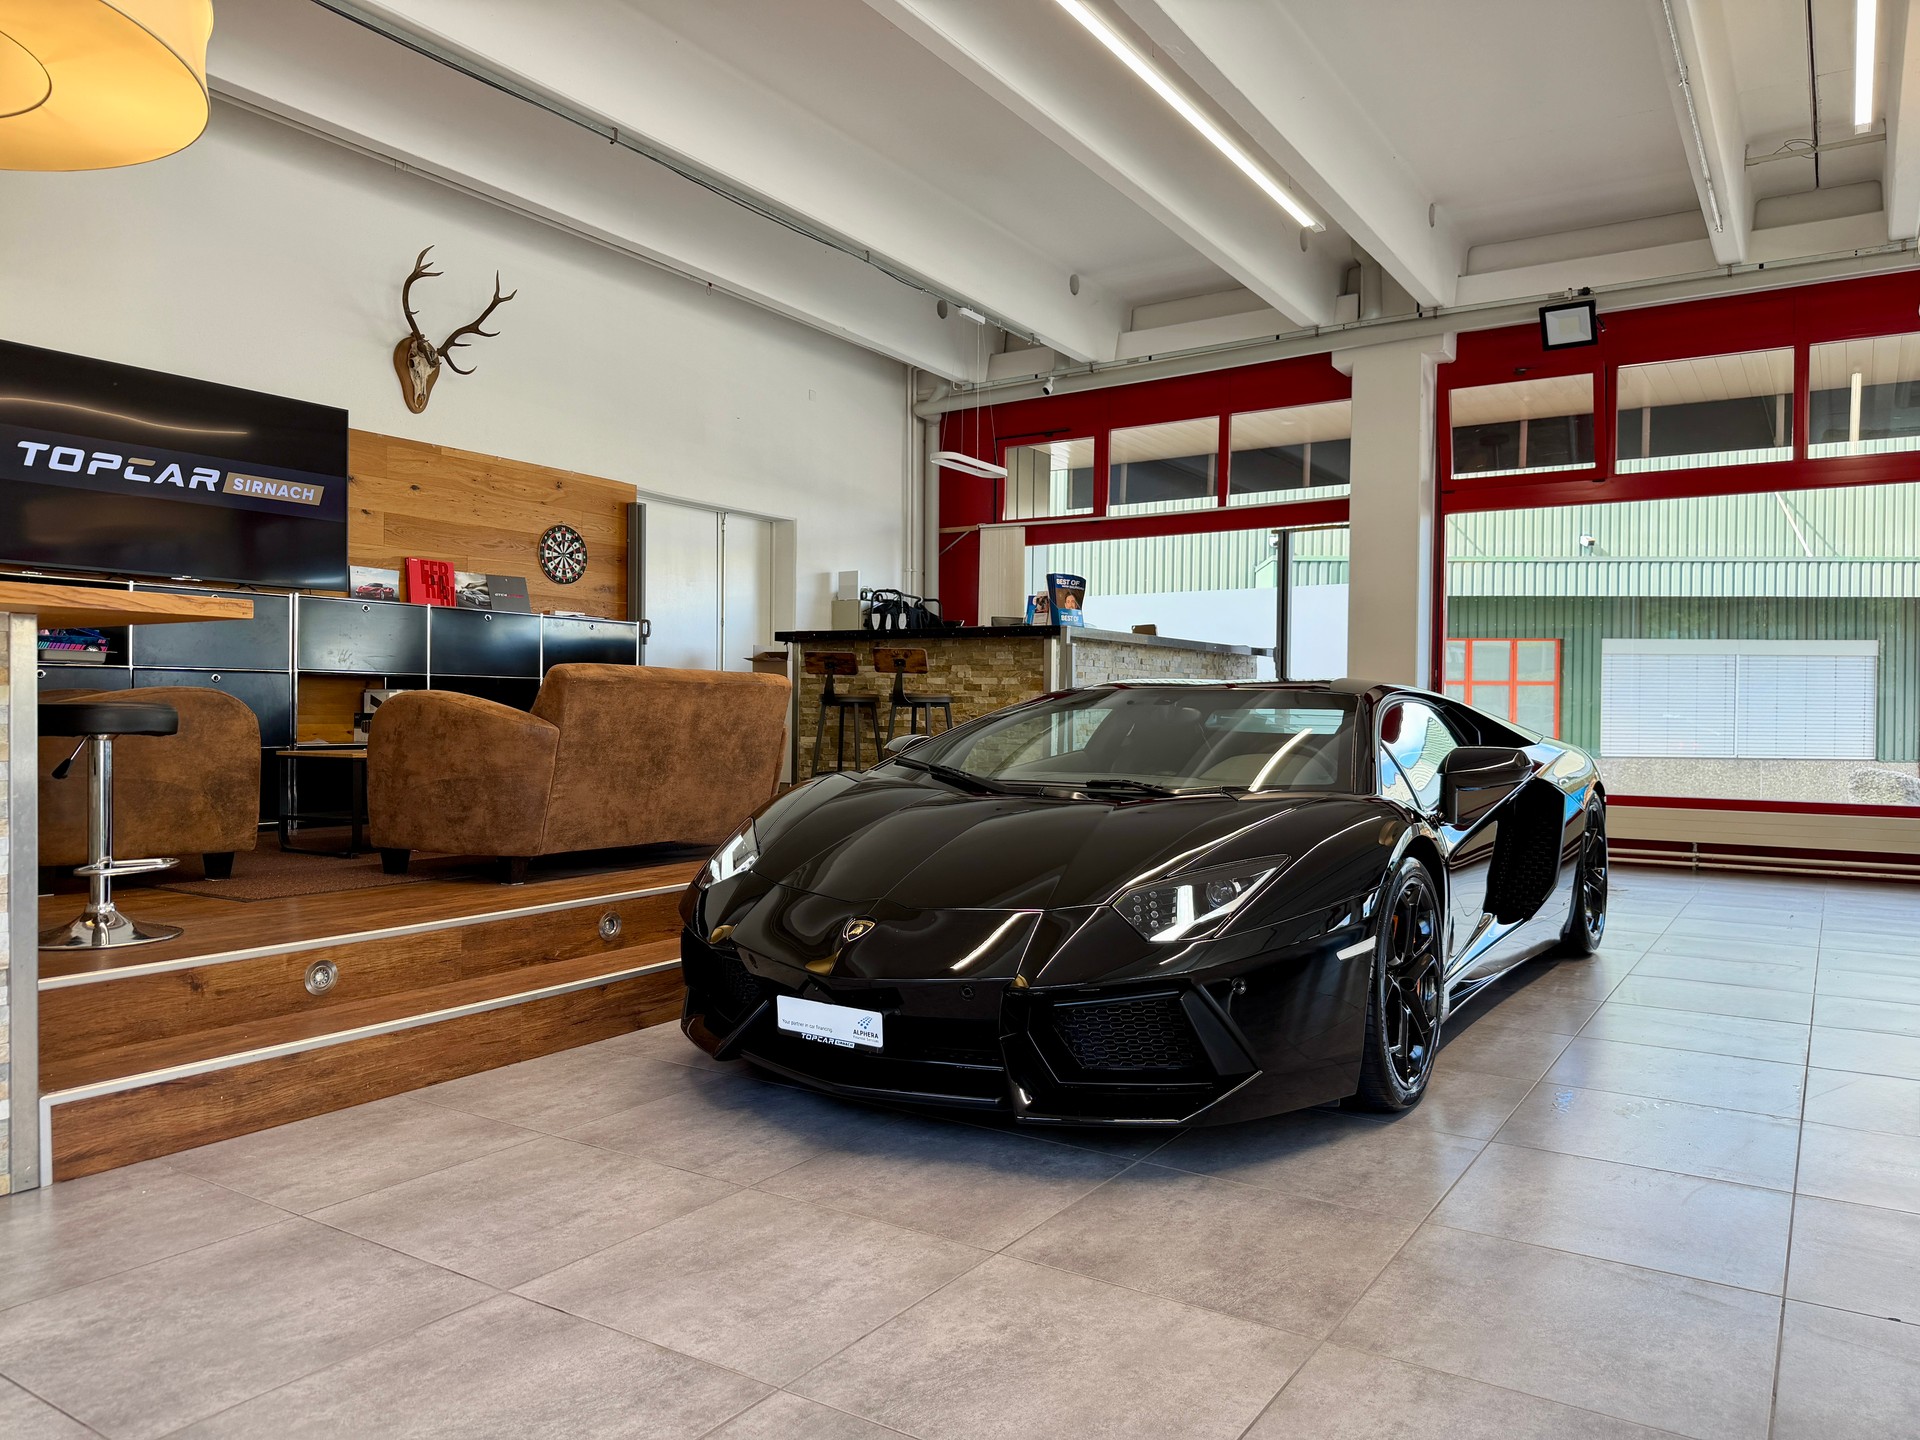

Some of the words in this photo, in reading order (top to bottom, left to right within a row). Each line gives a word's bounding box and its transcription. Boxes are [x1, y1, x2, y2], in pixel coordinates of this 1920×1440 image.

[17, 440, 221, 492] TOPCAR
[232, 478, 315, 501] SIRNACH
[1060, 614, 1073, 622] BEST
[801, 1032, 835, 1045] TOPCAR
[852, 1029, 879, 1039] ALPHERA
